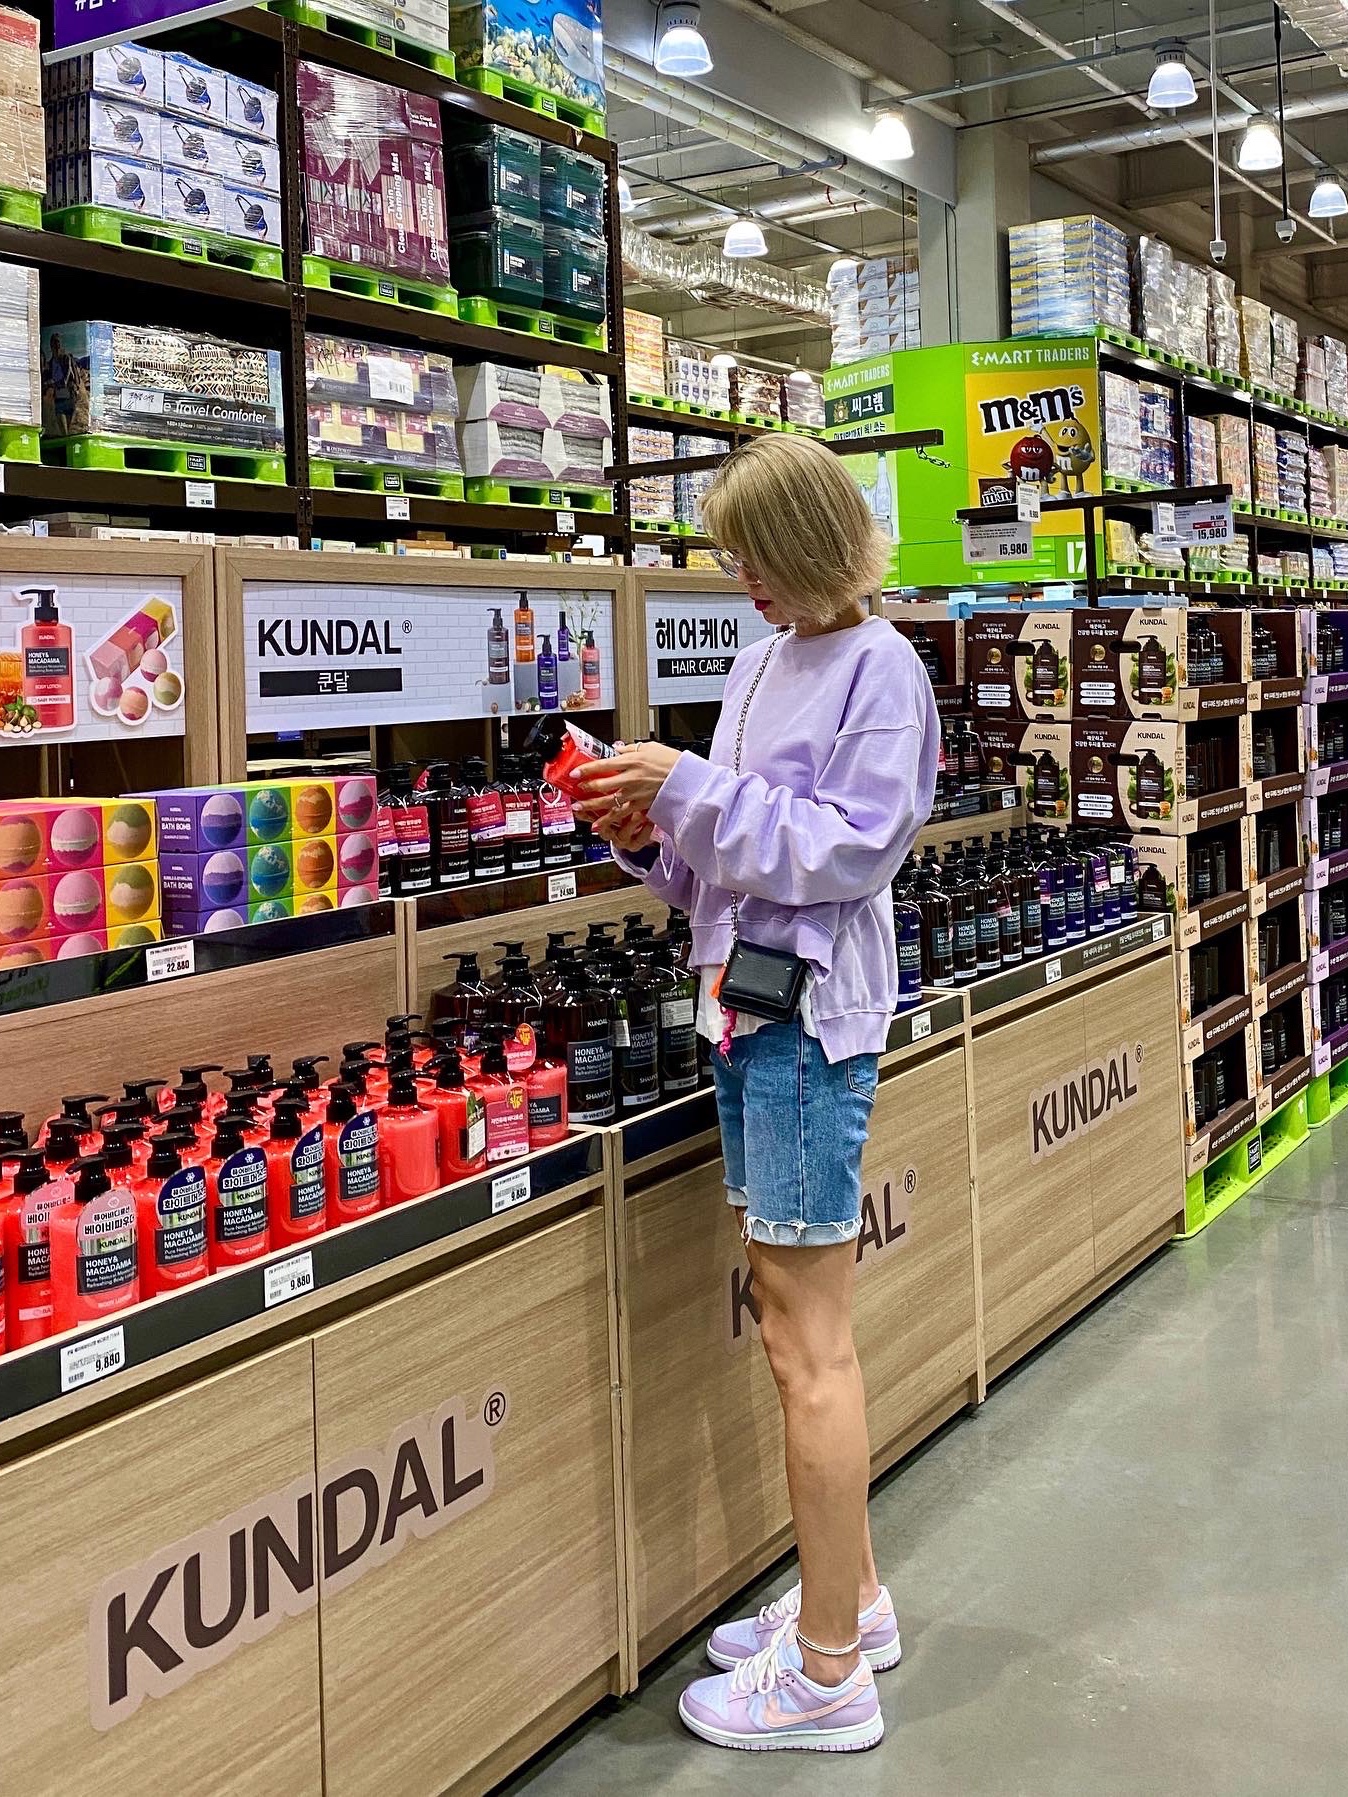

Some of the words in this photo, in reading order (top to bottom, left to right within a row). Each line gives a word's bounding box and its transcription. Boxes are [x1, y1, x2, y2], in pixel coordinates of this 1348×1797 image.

[391, 152, 399, 172] Mat
[424, 161, 432, 182] Mat
[395, 174, 403, 220] Camping
[426, 183, 435, 228] Camping
[397, 229, 406, 254] Cloud
[430, 236, 438, 260] Cloud
[1036, 347, 1090, 362] TRADERS
[860, 364, 890, 383] TRADERS
[851, 391, 885, 417] 씨그램
[175, 401, 210, 416] Travel
[212, 405, 267, 424] Comforter
[1021, 466, 1040, 480] m
[1197, 528, 1227, 540] 15,980
[999, 543, 1028, 556] 15,980
[655, 617, 739, 650] 헤어케어
[671, 660, 697, 675] HAIR
[699, 659, 726, 673] CARE
[317, 671, 350, 693] 쿤달
[1138, 732, 1166, 740] KUNDAL
[1139, 846, 1166, 854] KUNDAL
[178, 882, 193, 890] BOMB
[167, 959, 190, 973] 22,880
[587, 1018, 608, 1027] KUNDAL
[575, 1046, 604, 1056] HONEY&
[348, 1167, 372, 1178] HONEY&
[298, 1184, 320, 1195] HONEY&
[511, 1187, 527, 1202] 9,880
[223, 1207, 253, 1218] HONEY&
[223, 1210, 264, 1226] MACADAMIA
[99, 1235, 127, 1249] KUNDAL
[164, 1229, 193, 1240] HONEY&
[85, 1256, 118, 1268] HONEY&
[85, 1259, 132, 1277] MACADAMIA
[290, 1274, 310, 1291] 9,880
[95, 1352, 120, 1373] 9,880
